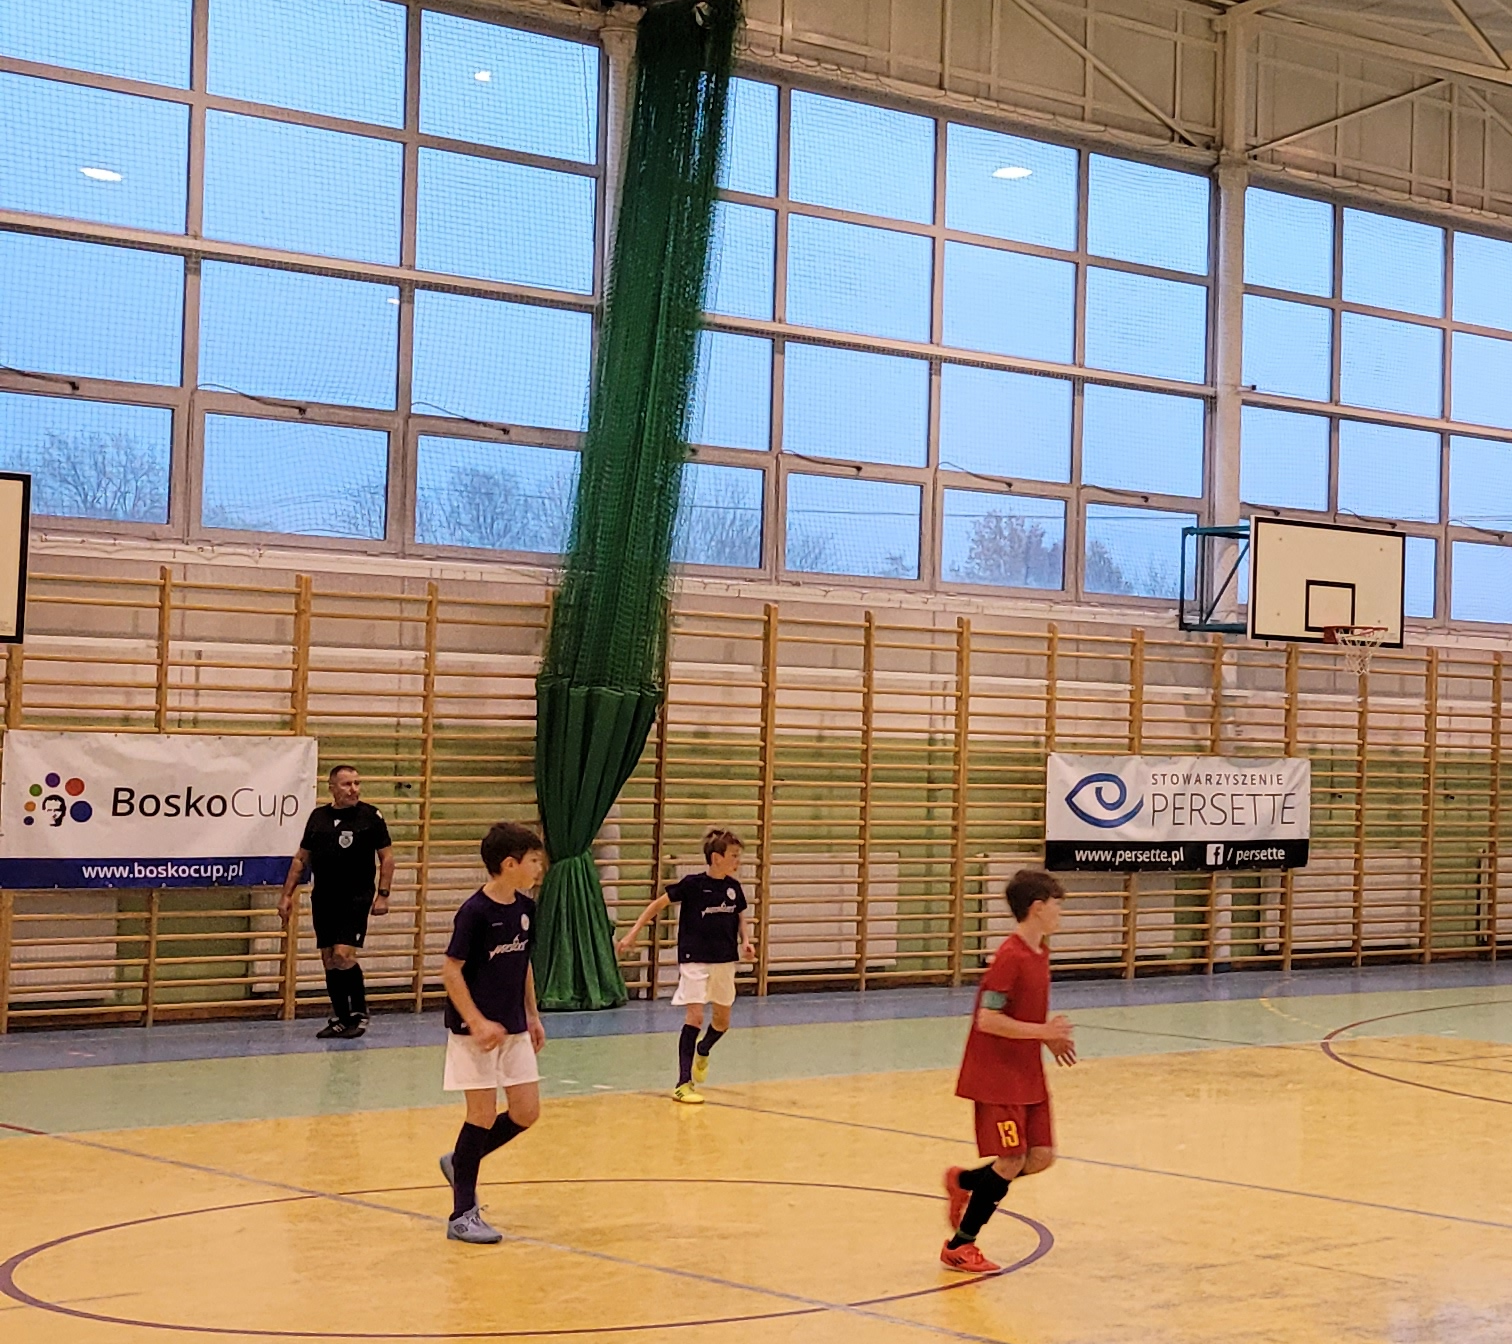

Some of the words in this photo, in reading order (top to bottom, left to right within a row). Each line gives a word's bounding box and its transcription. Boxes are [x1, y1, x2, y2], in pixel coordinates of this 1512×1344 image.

[1151, 773, 1284, 786] STOWARZYSZENIE
[111, 785, 299, 826] BoskoCup
[1151, 792, 1296, 827] PERSETTE
[1075, 847, 1184, 864] www.persette.pl
[82, 861, 243, 881] www.boskocup.pl
[996, 1120, 1020, 1148] 13
